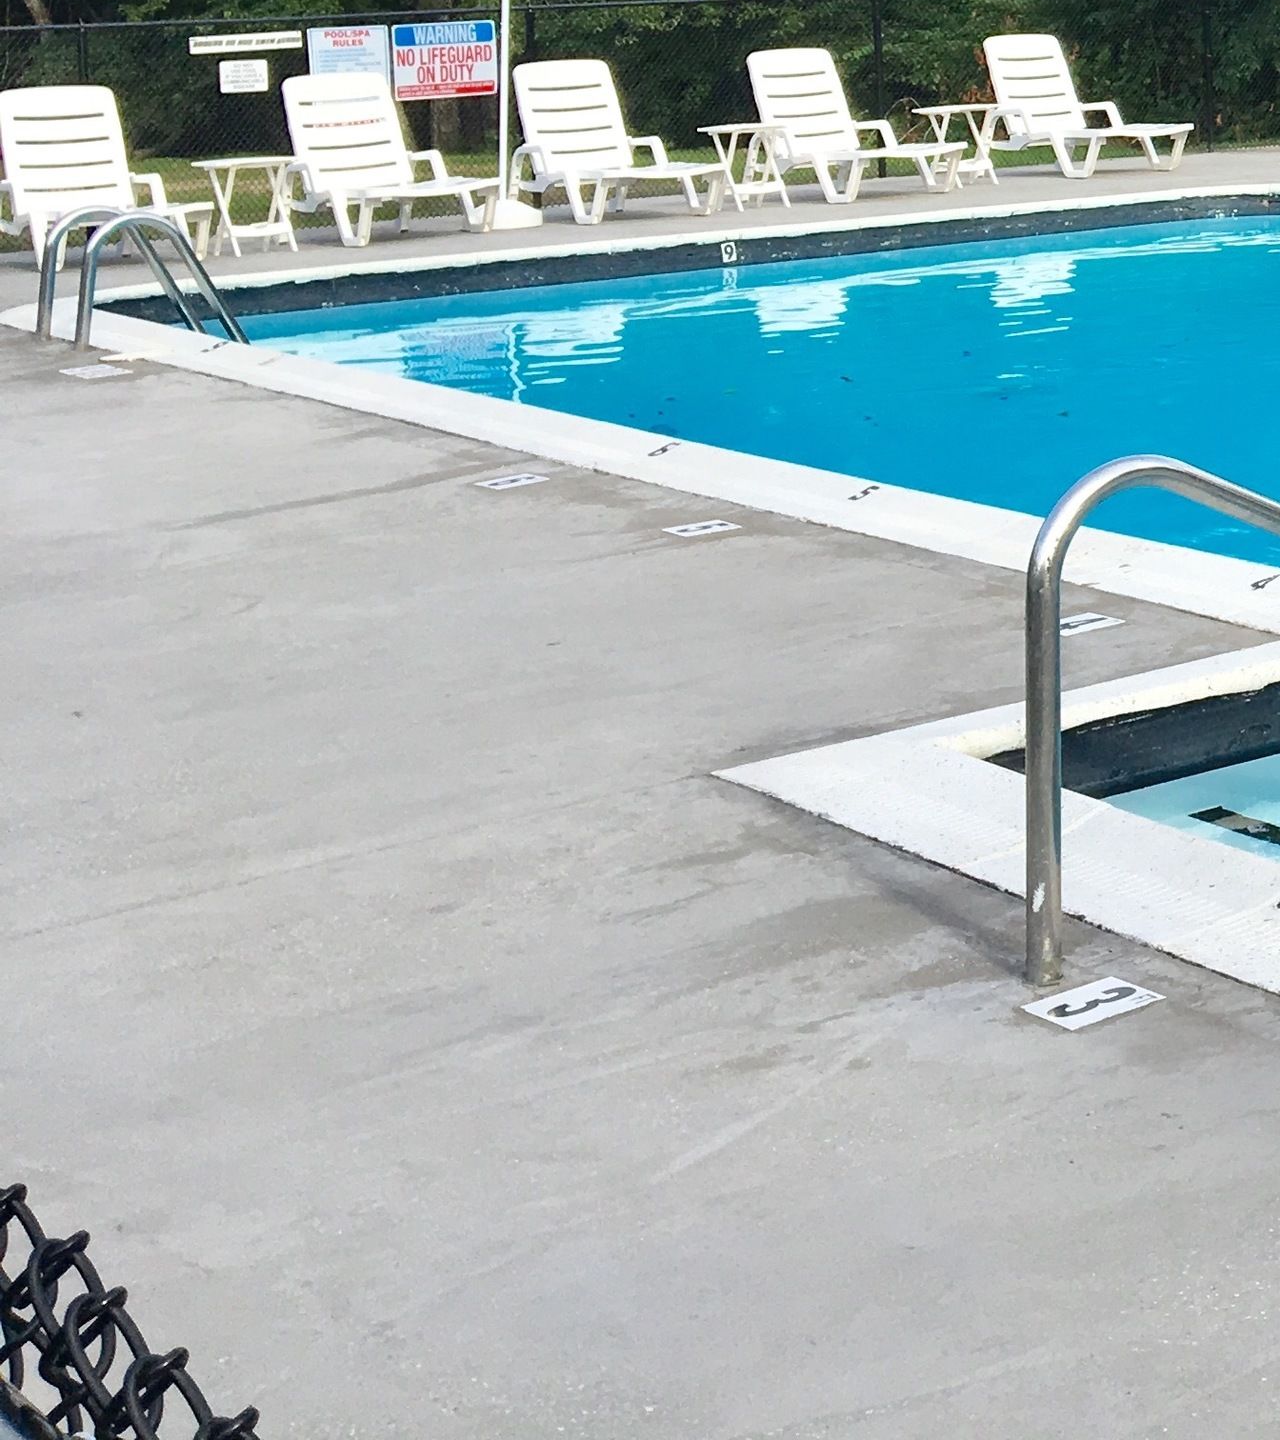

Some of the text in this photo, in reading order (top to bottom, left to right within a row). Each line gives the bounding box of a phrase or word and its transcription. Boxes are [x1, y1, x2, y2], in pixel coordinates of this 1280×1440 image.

[323, 29, 371, 39] POOL/SPA
[332, 39, 364, 48] RULES
[412, 23, 477, 45] WARNING
[396, 48, 415, 67] NO
[419, 44, 493, 65] LIFEGUARD
[416, 63, 474, 84] ON DUTY
[724, 244, 734, 260] 9
[1046, 986, 1137, 1018] 3
